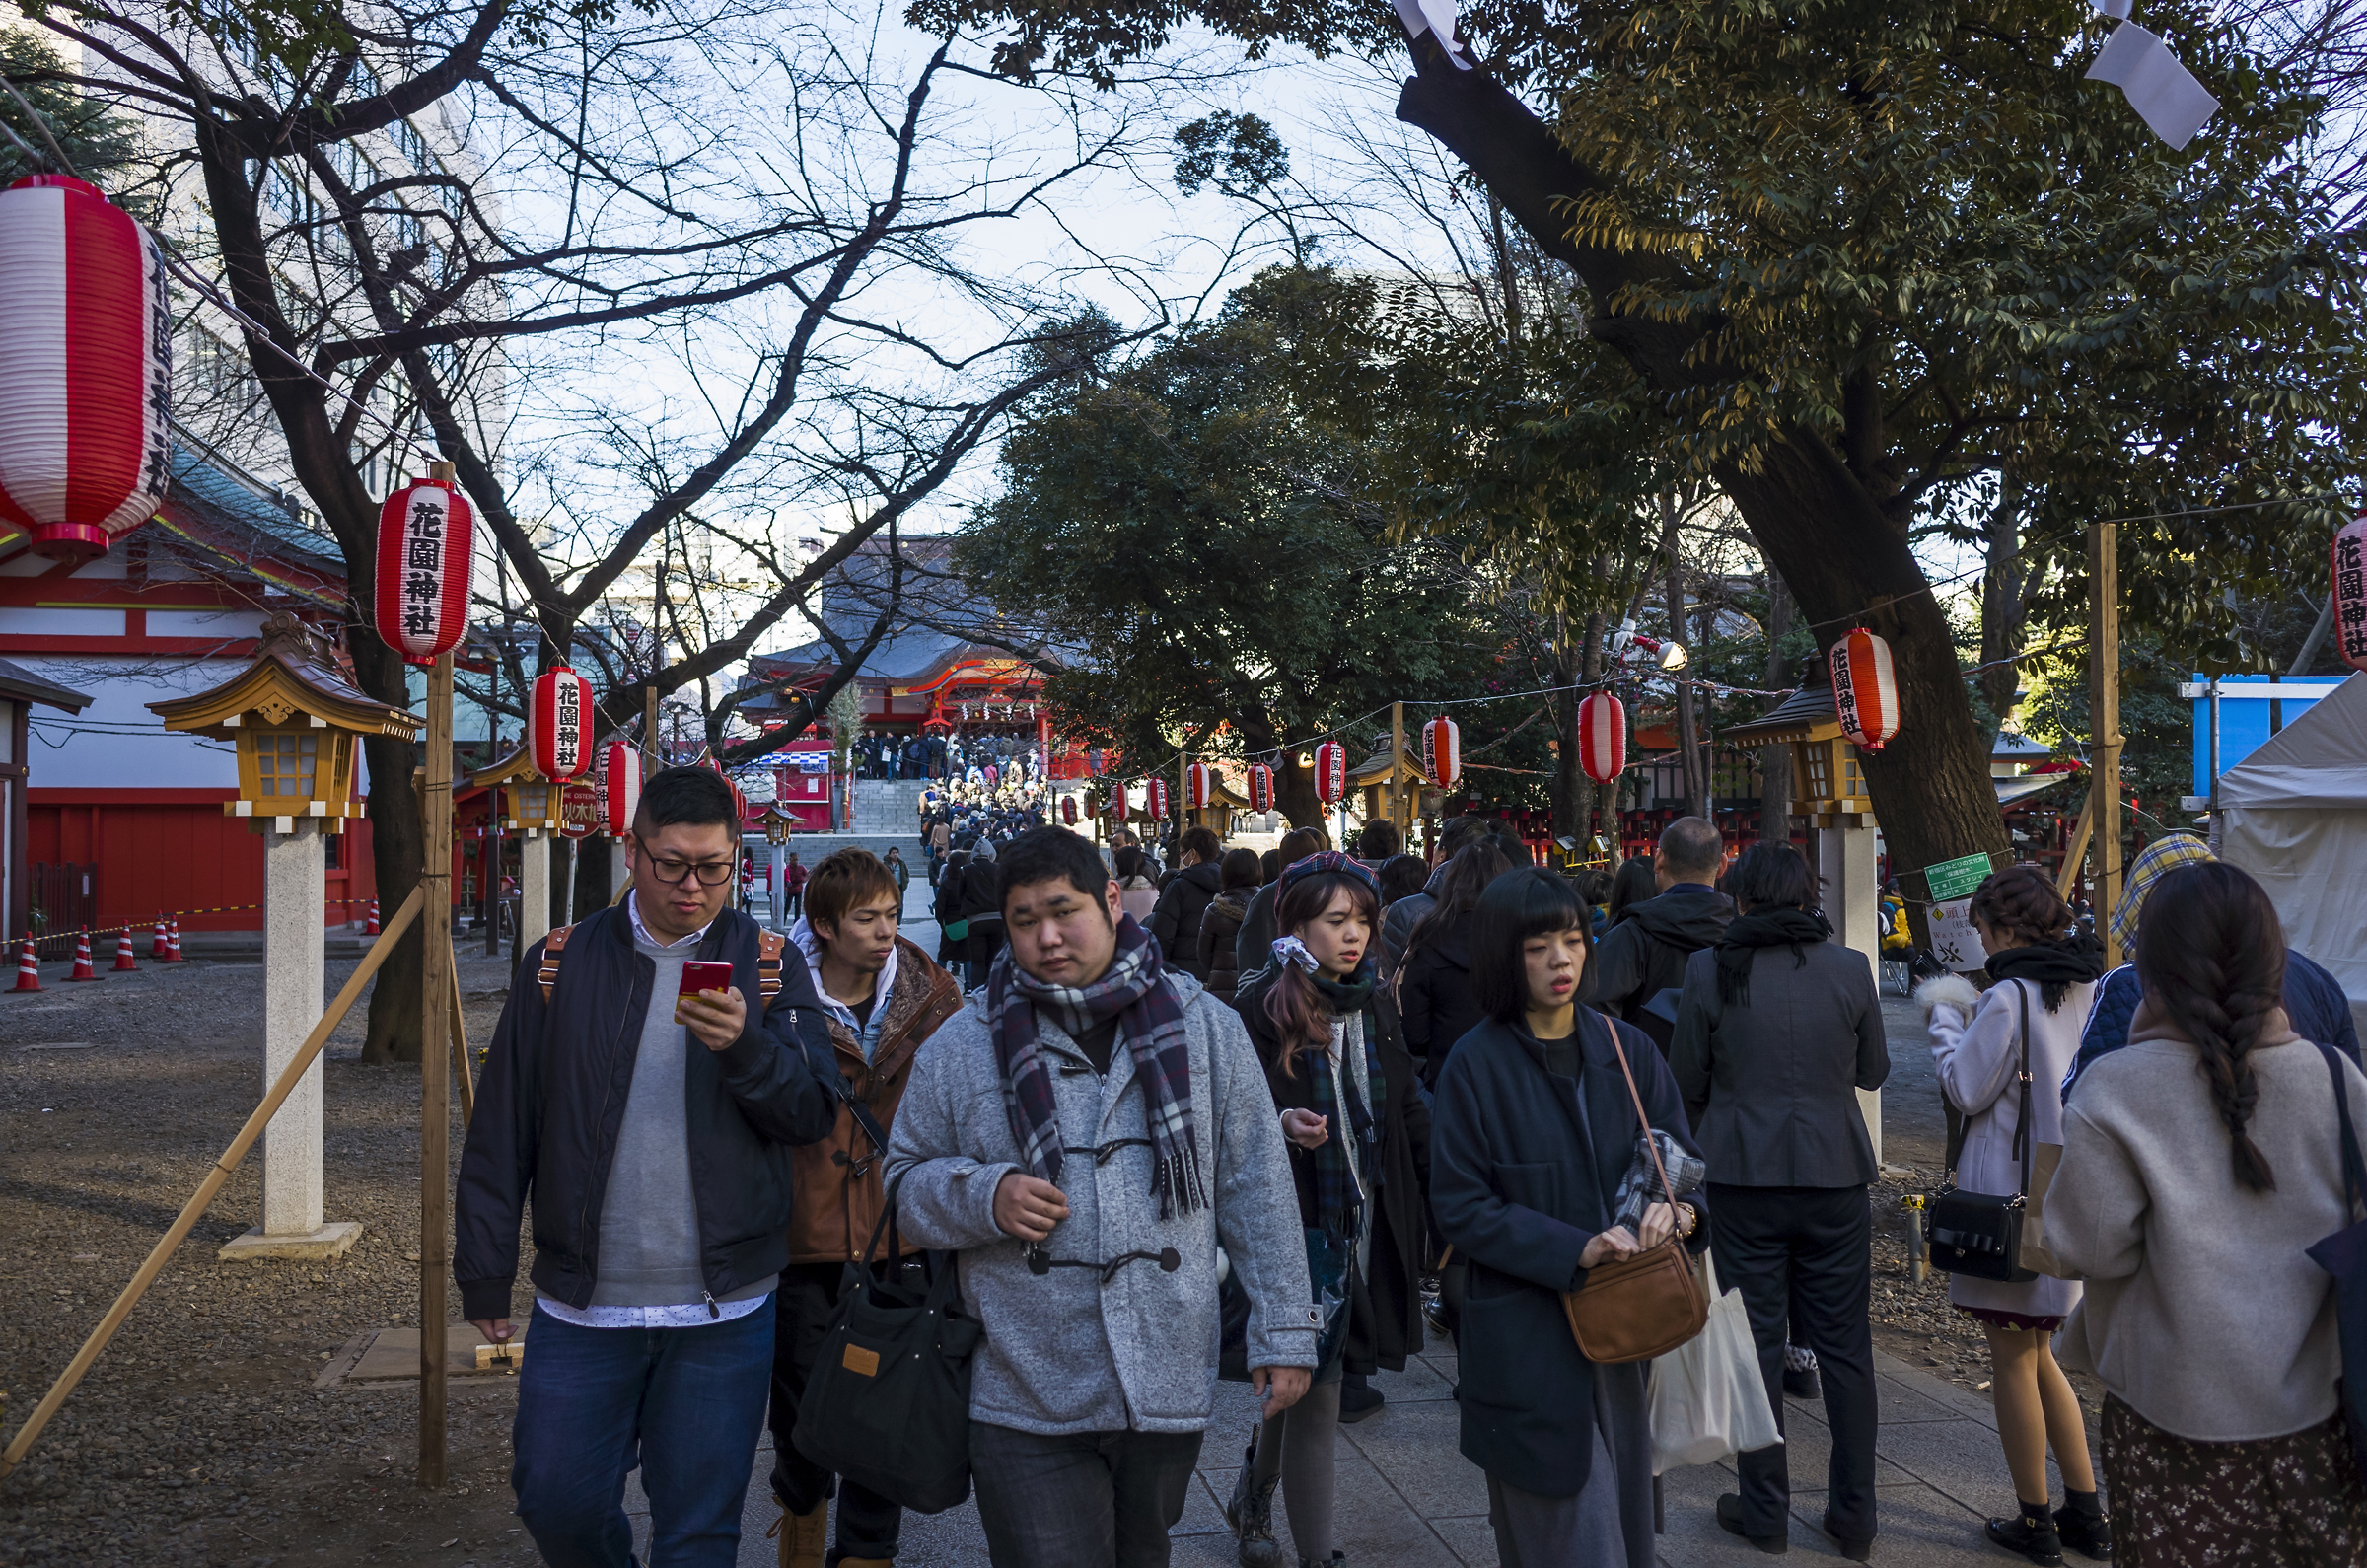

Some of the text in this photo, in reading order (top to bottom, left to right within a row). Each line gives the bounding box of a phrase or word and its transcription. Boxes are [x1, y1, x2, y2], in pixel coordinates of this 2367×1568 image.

[403, 502, 445, 636] 花園神社
[2336, 535, 2367, 659] 花園神社
[556, 682, 579, 767] 花園神社
[1832, 648, 1862, 736] 花園神社
[596, 750, 610, 825] 花園神社
[1256, 771, 1267, 809] 花園神社
[1328, 747, 1342, 798] 花園神社
[1424, 728, 1438, 780] 花園神社
[1933, 929, 1972, 939] Watch
